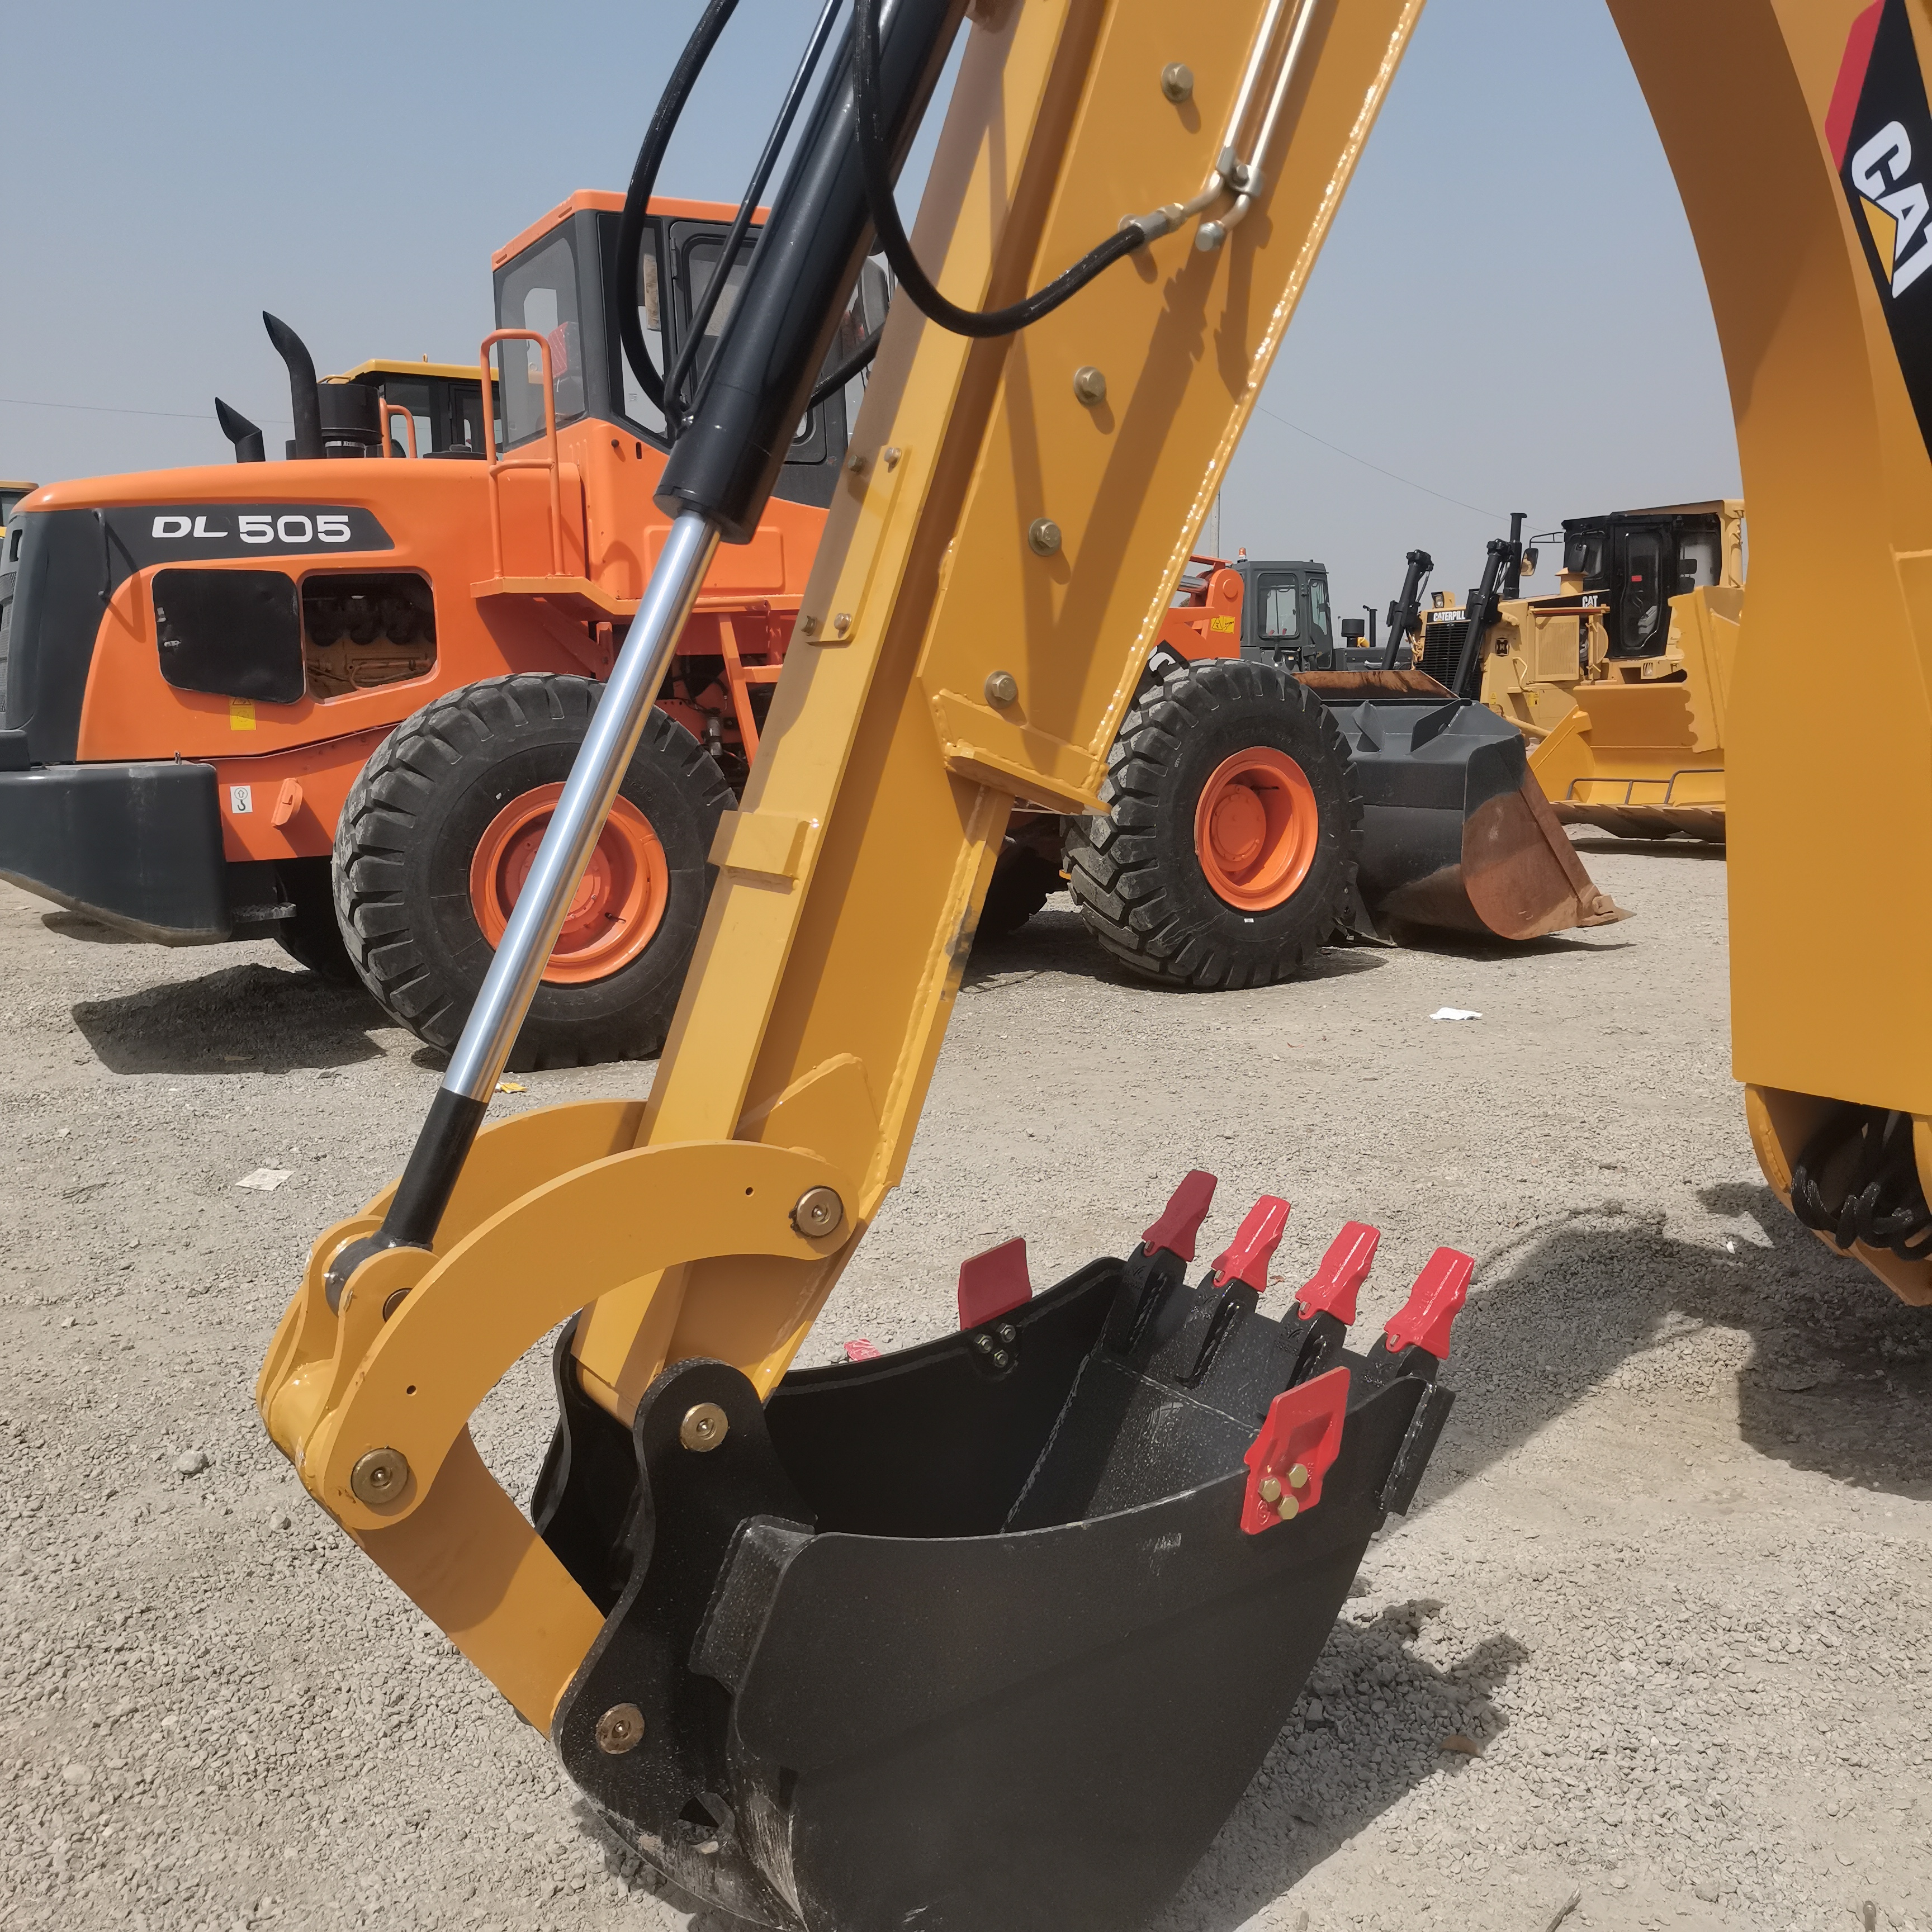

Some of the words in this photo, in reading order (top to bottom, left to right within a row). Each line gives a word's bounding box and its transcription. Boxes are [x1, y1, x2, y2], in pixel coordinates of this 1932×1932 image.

[152, 516, 228, 538] DL
[238, 515, 351, 543] 505
[1582, 595, 1598, 608] CAT
